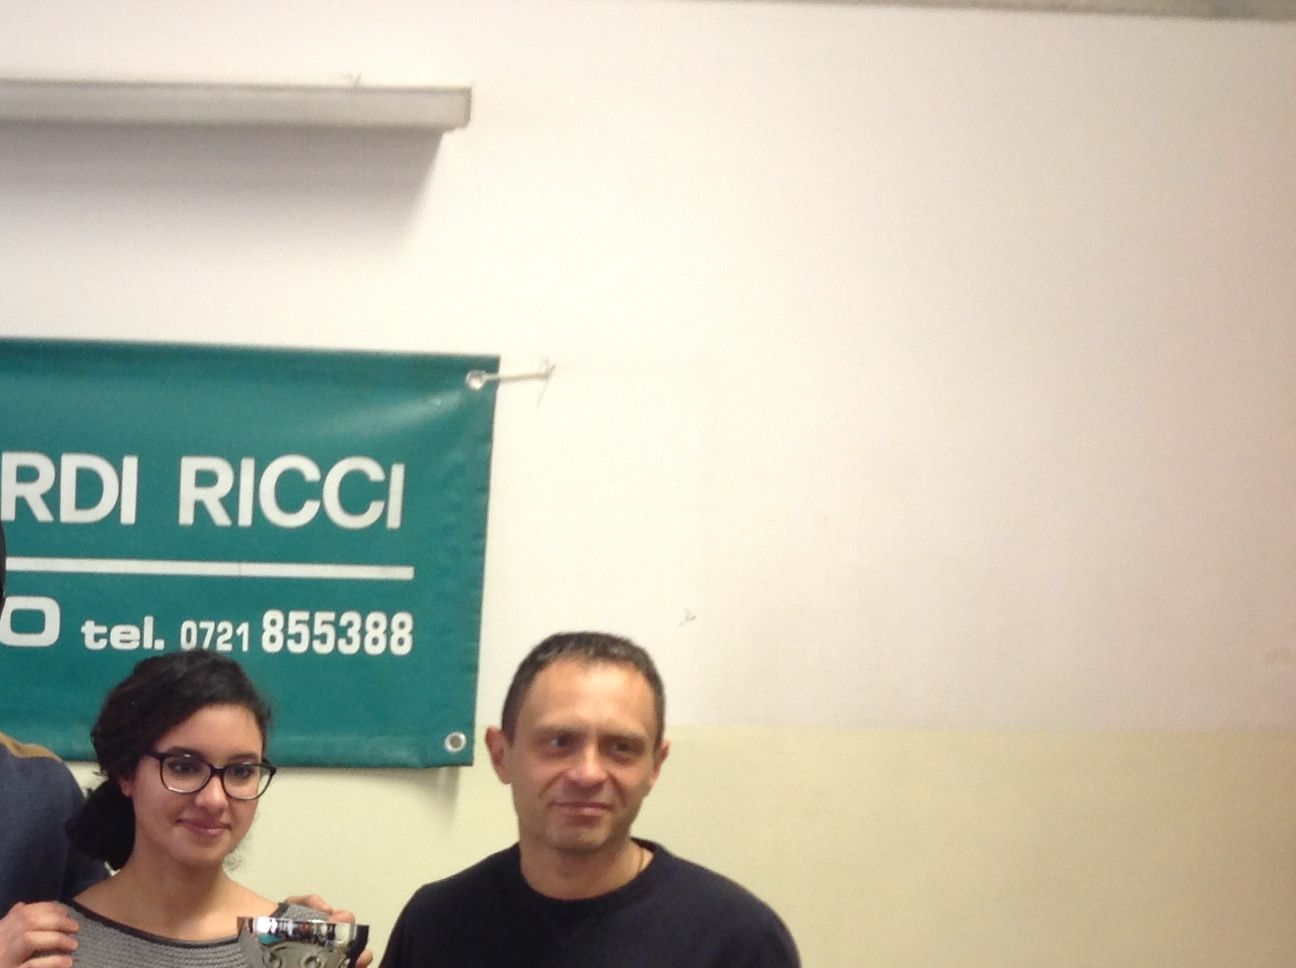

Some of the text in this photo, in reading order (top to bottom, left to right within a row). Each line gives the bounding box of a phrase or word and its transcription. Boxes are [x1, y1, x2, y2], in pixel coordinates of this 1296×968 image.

[179, 454, 405, 529] RICCI
[81, 616, 164, 650] tel.
[180, 620, 249, 651] 0721
[261, 610, 413, 655] 855388
